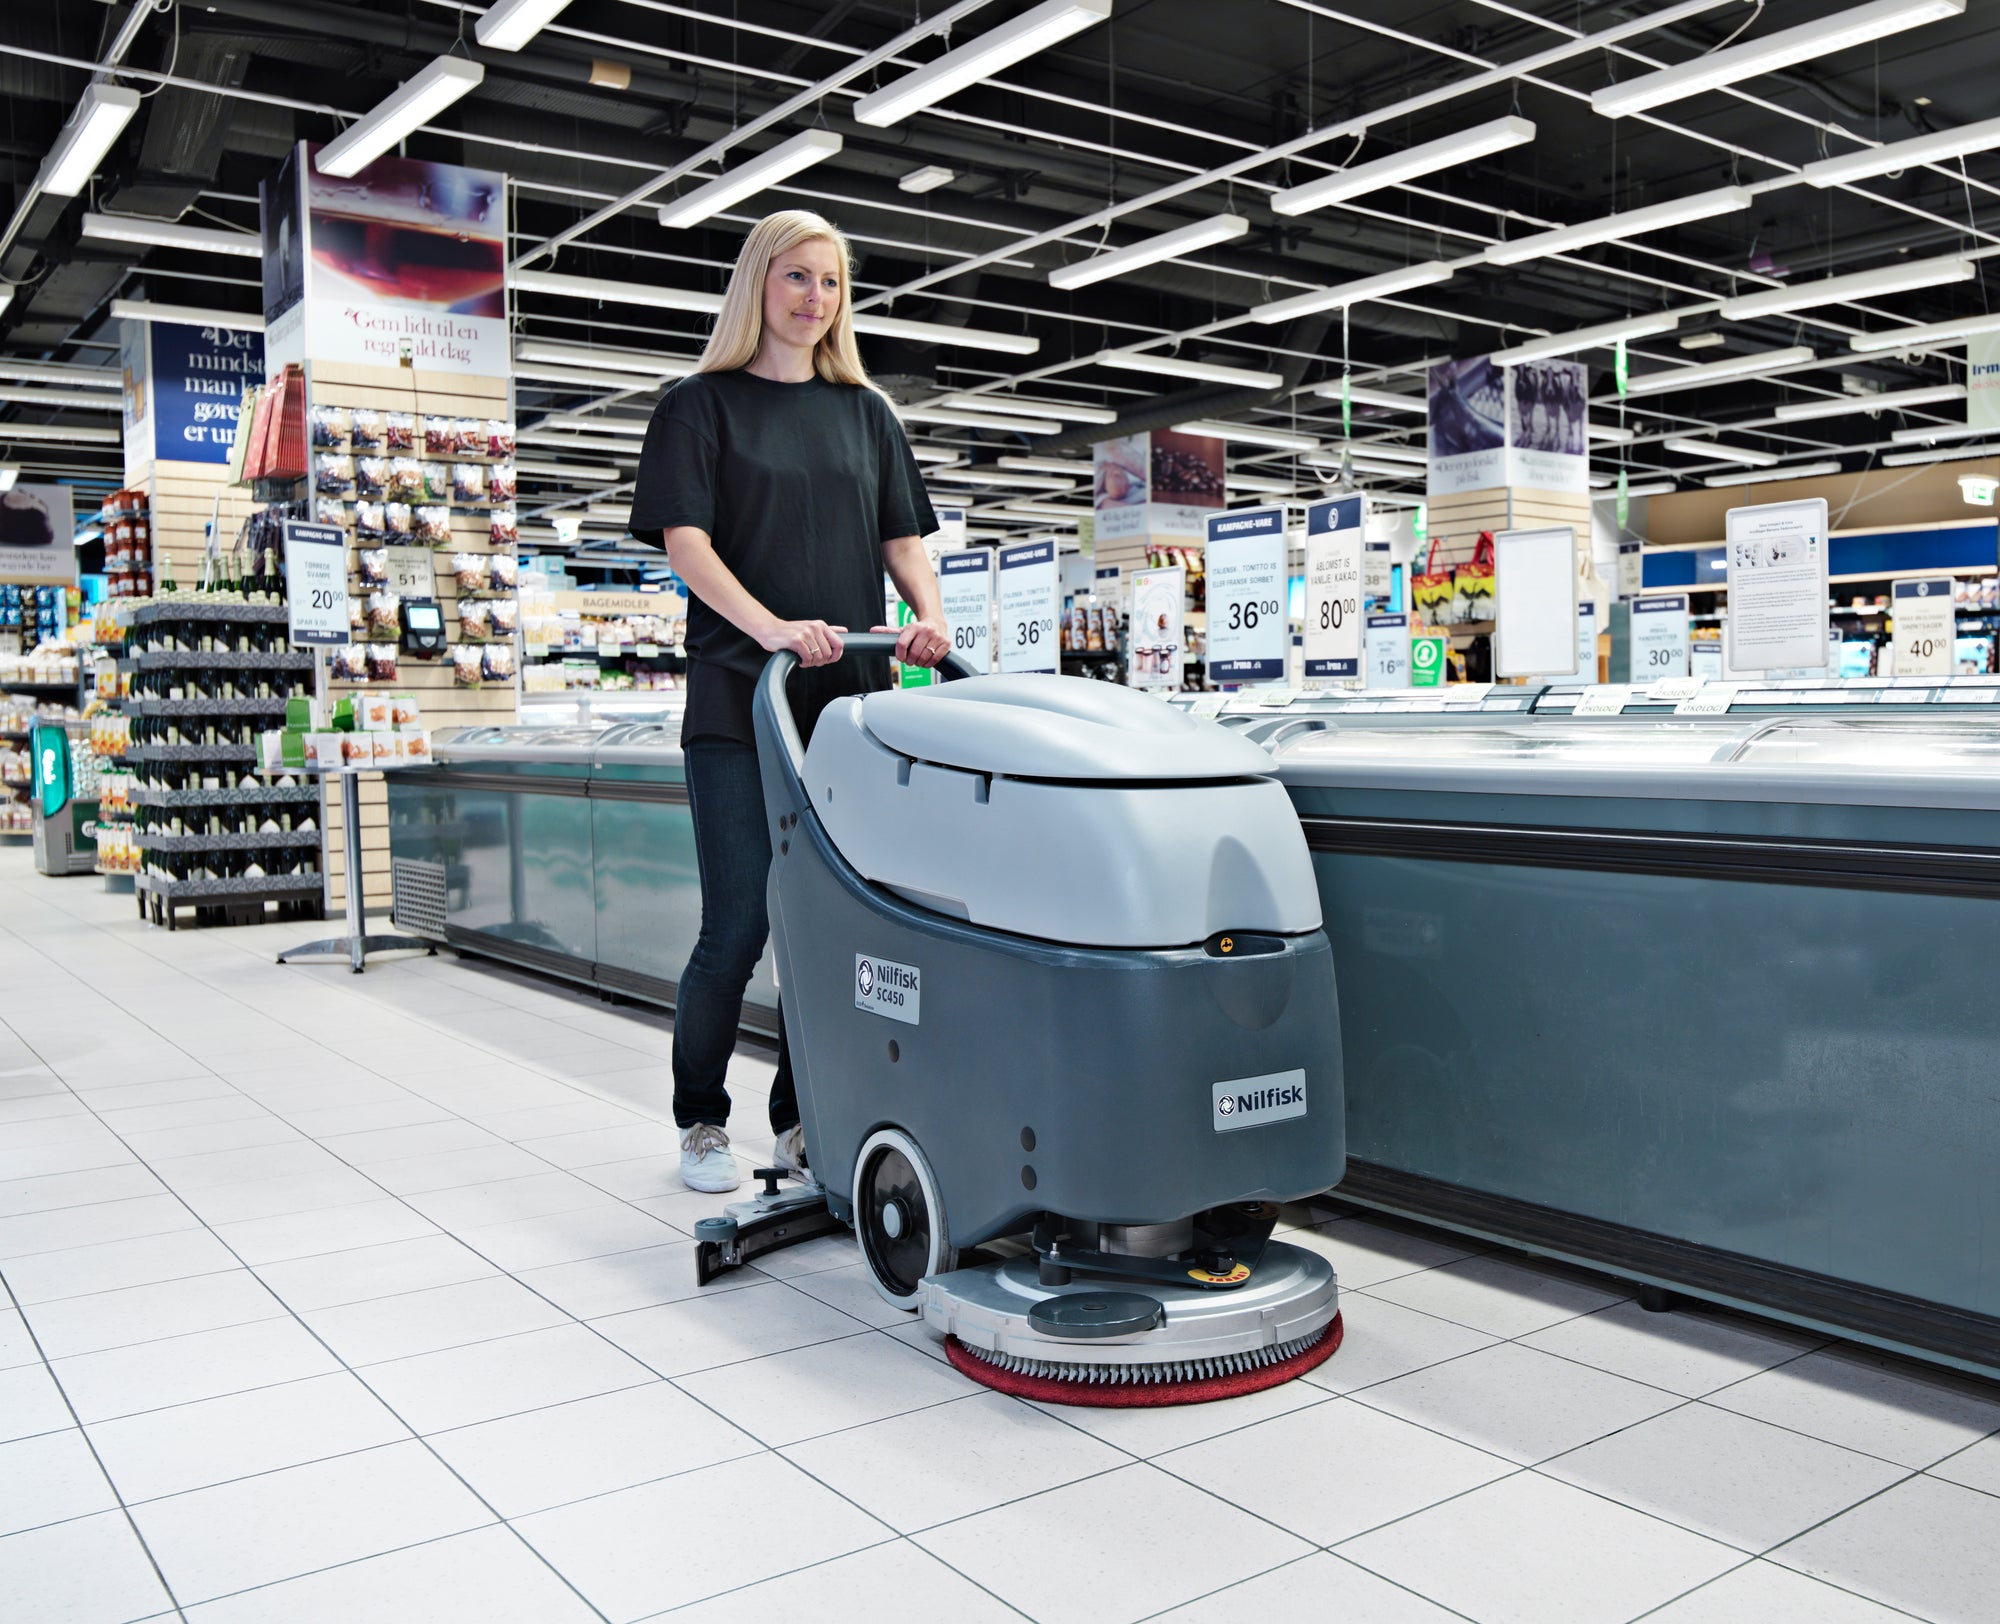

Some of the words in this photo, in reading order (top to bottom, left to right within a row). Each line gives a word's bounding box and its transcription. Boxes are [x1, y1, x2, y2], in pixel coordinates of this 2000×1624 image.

[405, 315, 433, 336] lidt
[437, 319, 454, 337] til
[457, 326, 478, 340] en
[188, 349, 266, 374] mindst
[440, 341, 471, 364] dag
[184, 376, 237, 396] man
[184, 424, 208, 442] er
[1217, 518, 1273, 533] KAMPAGNE-VARE
[1242, 563, 1269, 572] TONITTO
[1270, 562, 1277, 570] IS
[1249, 576, 1274, 584] SORBET
[1334, 571, 1357, 583] KAKAO
[583, 598, 650, 609] BAGEMIDLER
[877, 965, 918, 991] Nilfisk
[877, 987, 904, 1006] SC450
[1237, 1085, 1304, 1113] Nilfisk
